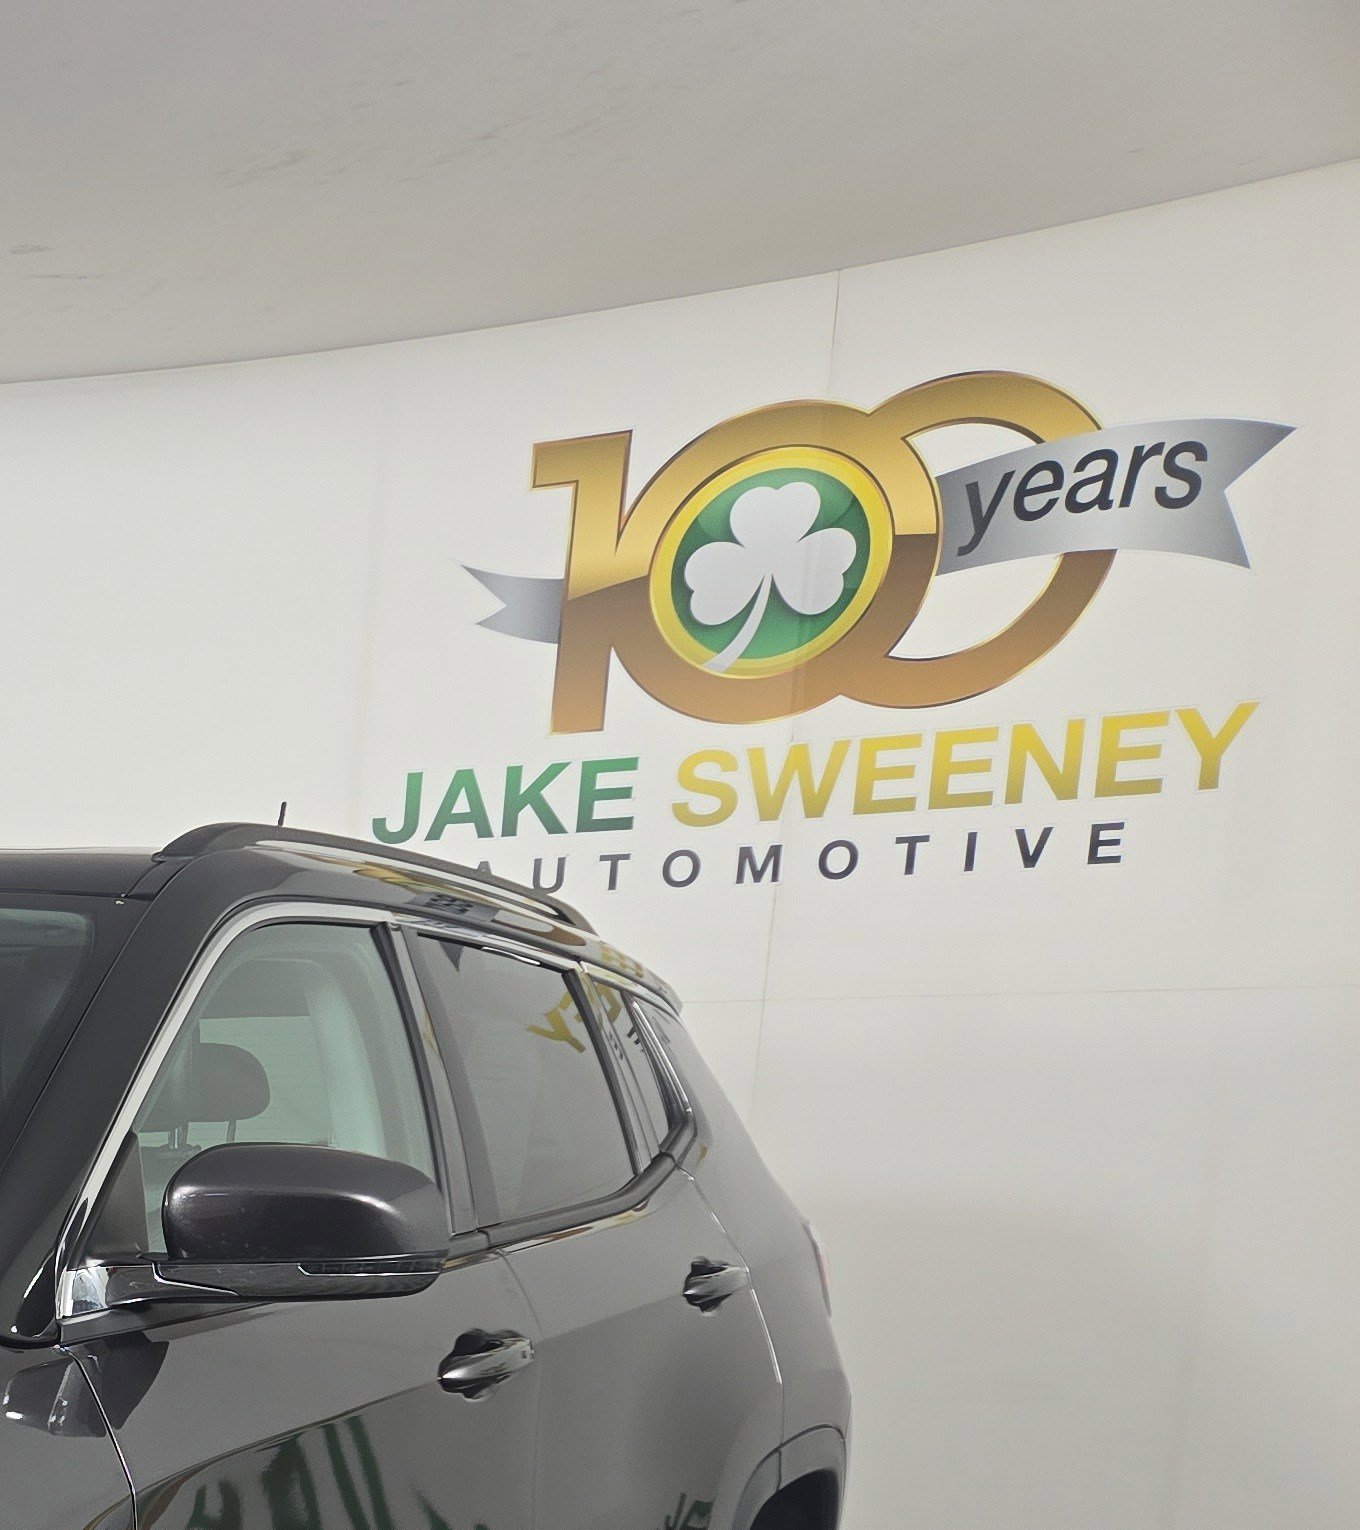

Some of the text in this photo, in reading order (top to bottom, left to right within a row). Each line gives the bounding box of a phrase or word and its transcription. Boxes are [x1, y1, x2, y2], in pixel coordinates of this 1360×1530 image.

[955, 439, 1208, 557] years
[372, 700, 1260, 845] JAKE SWEENEY
[477, 821, 1126, 895] UTOMOTIVE
